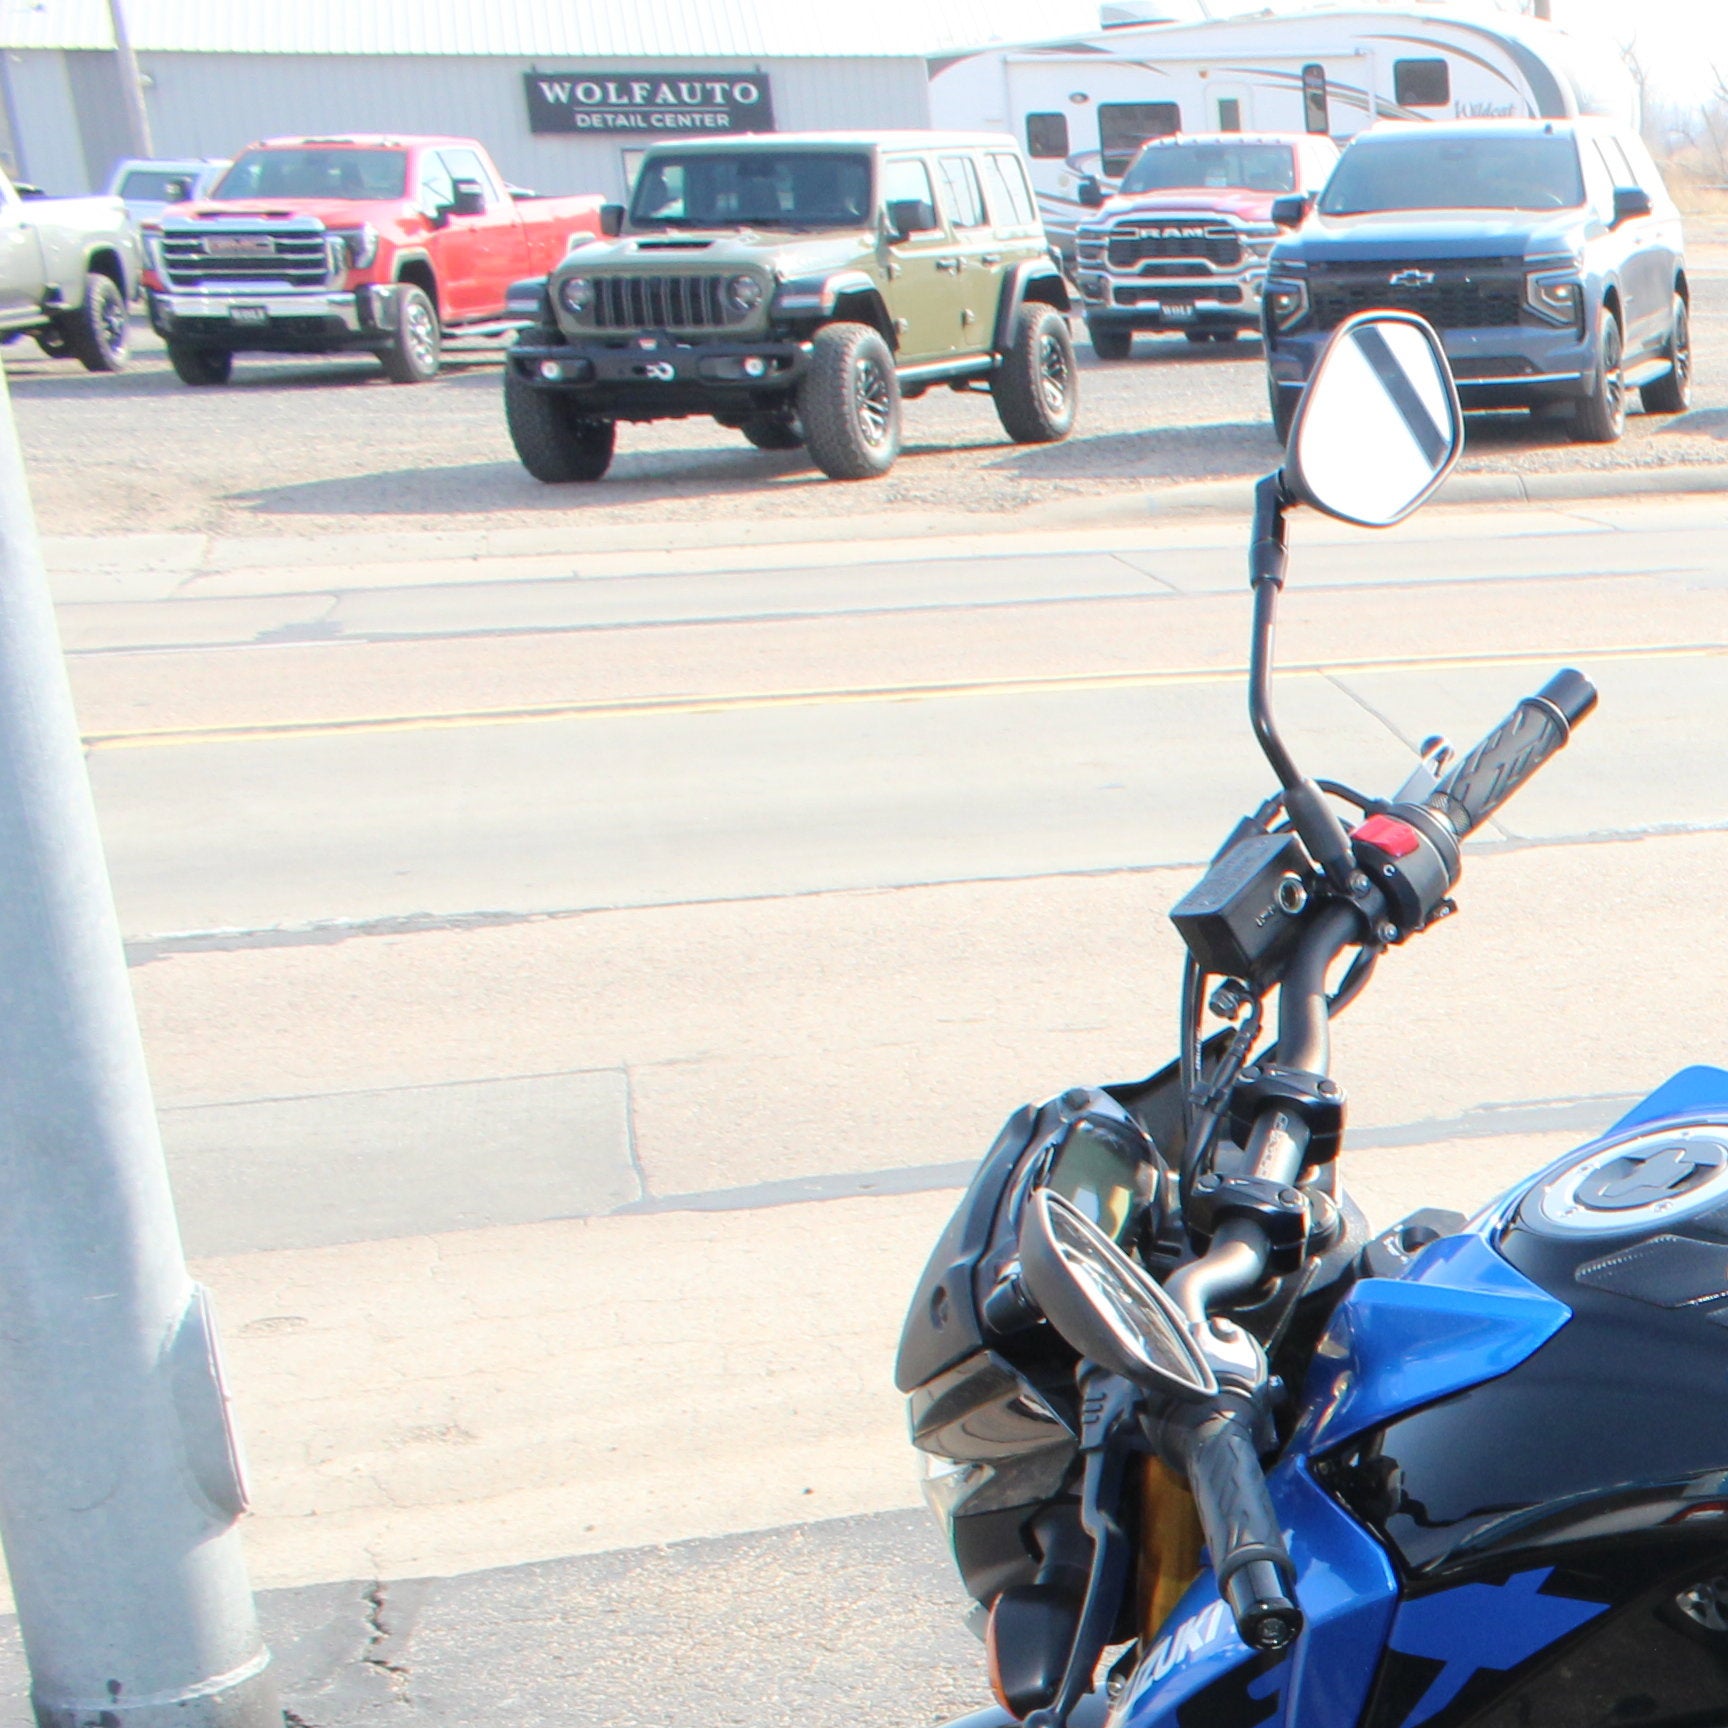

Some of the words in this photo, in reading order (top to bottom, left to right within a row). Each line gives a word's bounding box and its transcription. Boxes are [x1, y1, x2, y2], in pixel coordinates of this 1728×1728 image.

[575, 113, 647, 128] DETAIL
[650, 113, 731, 128] CENTER
[1140, 227, 1205, 239] RAM
